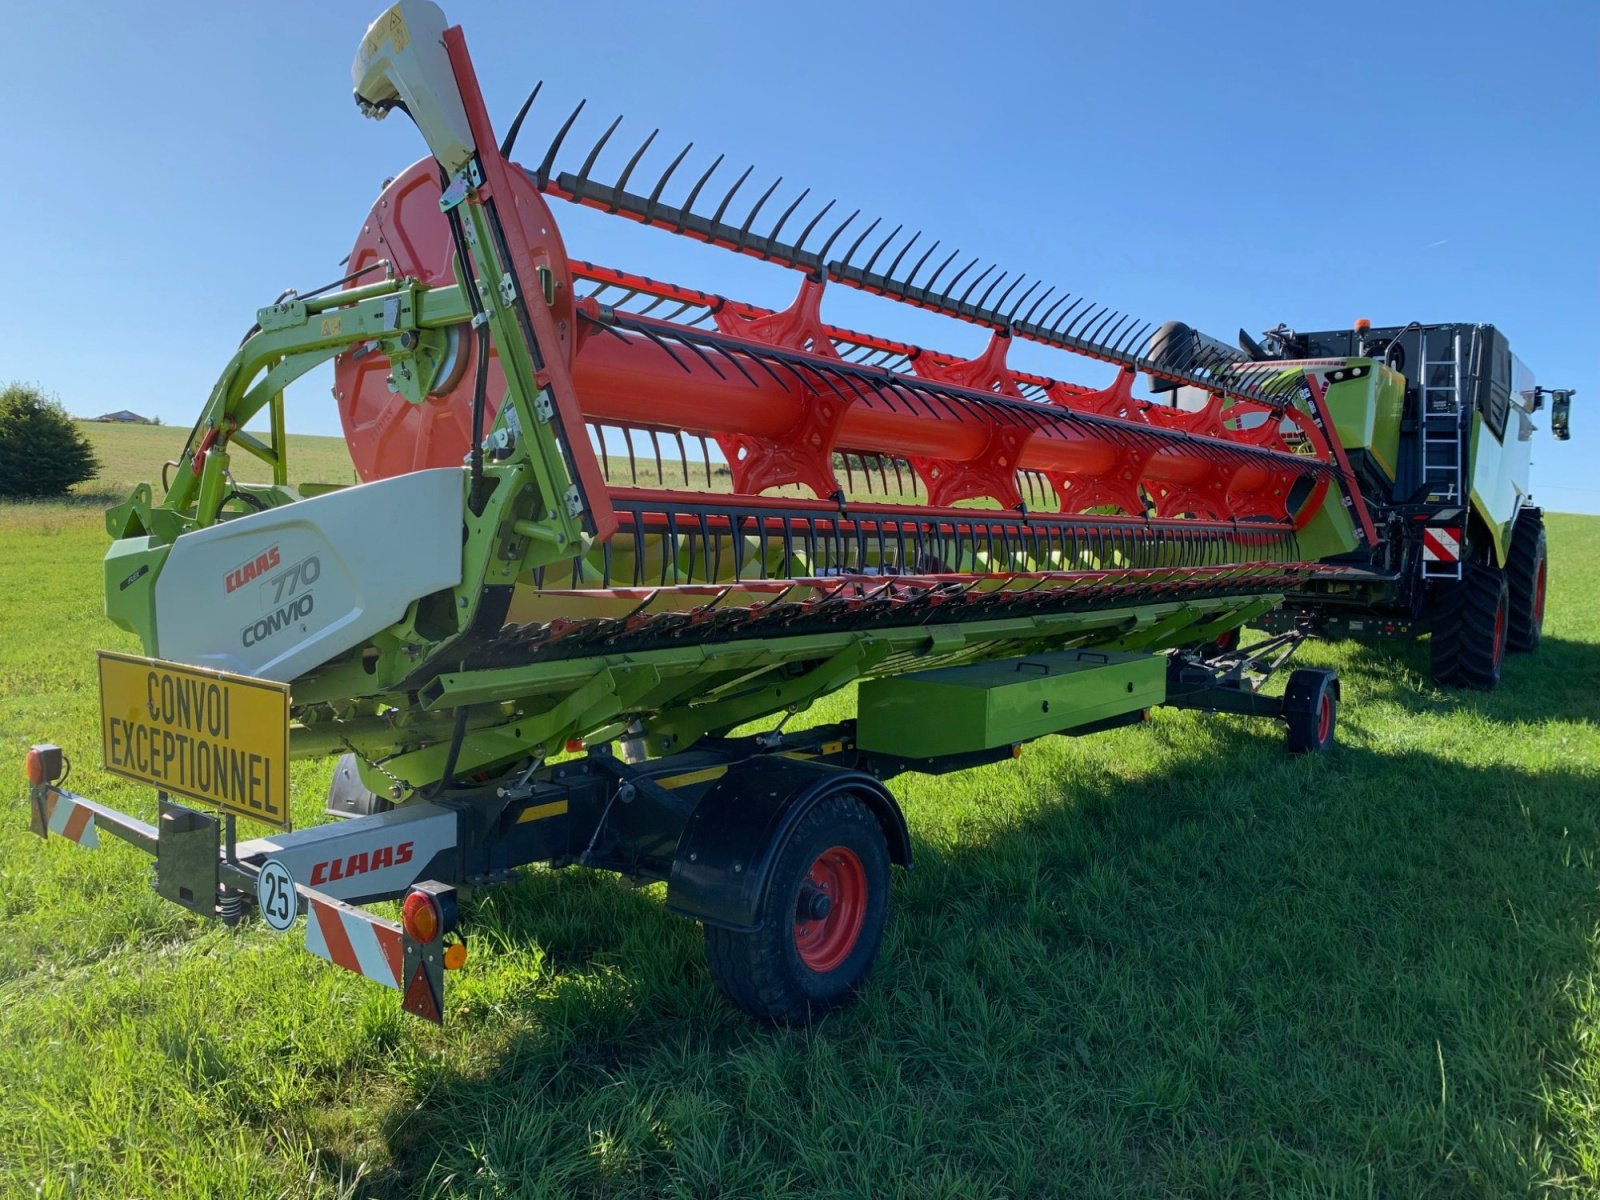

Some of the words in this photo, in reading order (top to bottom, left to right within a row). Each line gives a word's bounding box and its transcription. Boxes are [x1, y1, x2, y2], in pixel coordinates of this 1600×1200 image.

[225, 545, 280, 593] CLAAS
[271, 556, 320, 604] 770
[242, 594, 314, 648] CONVIO
[147, 671, 229, 739] CONVOI
[110, 716, 278, 815] EXCEPTIONNEL
[310, 841, 414, 886] CLAAS
[265, 871, 289, 921] 25
